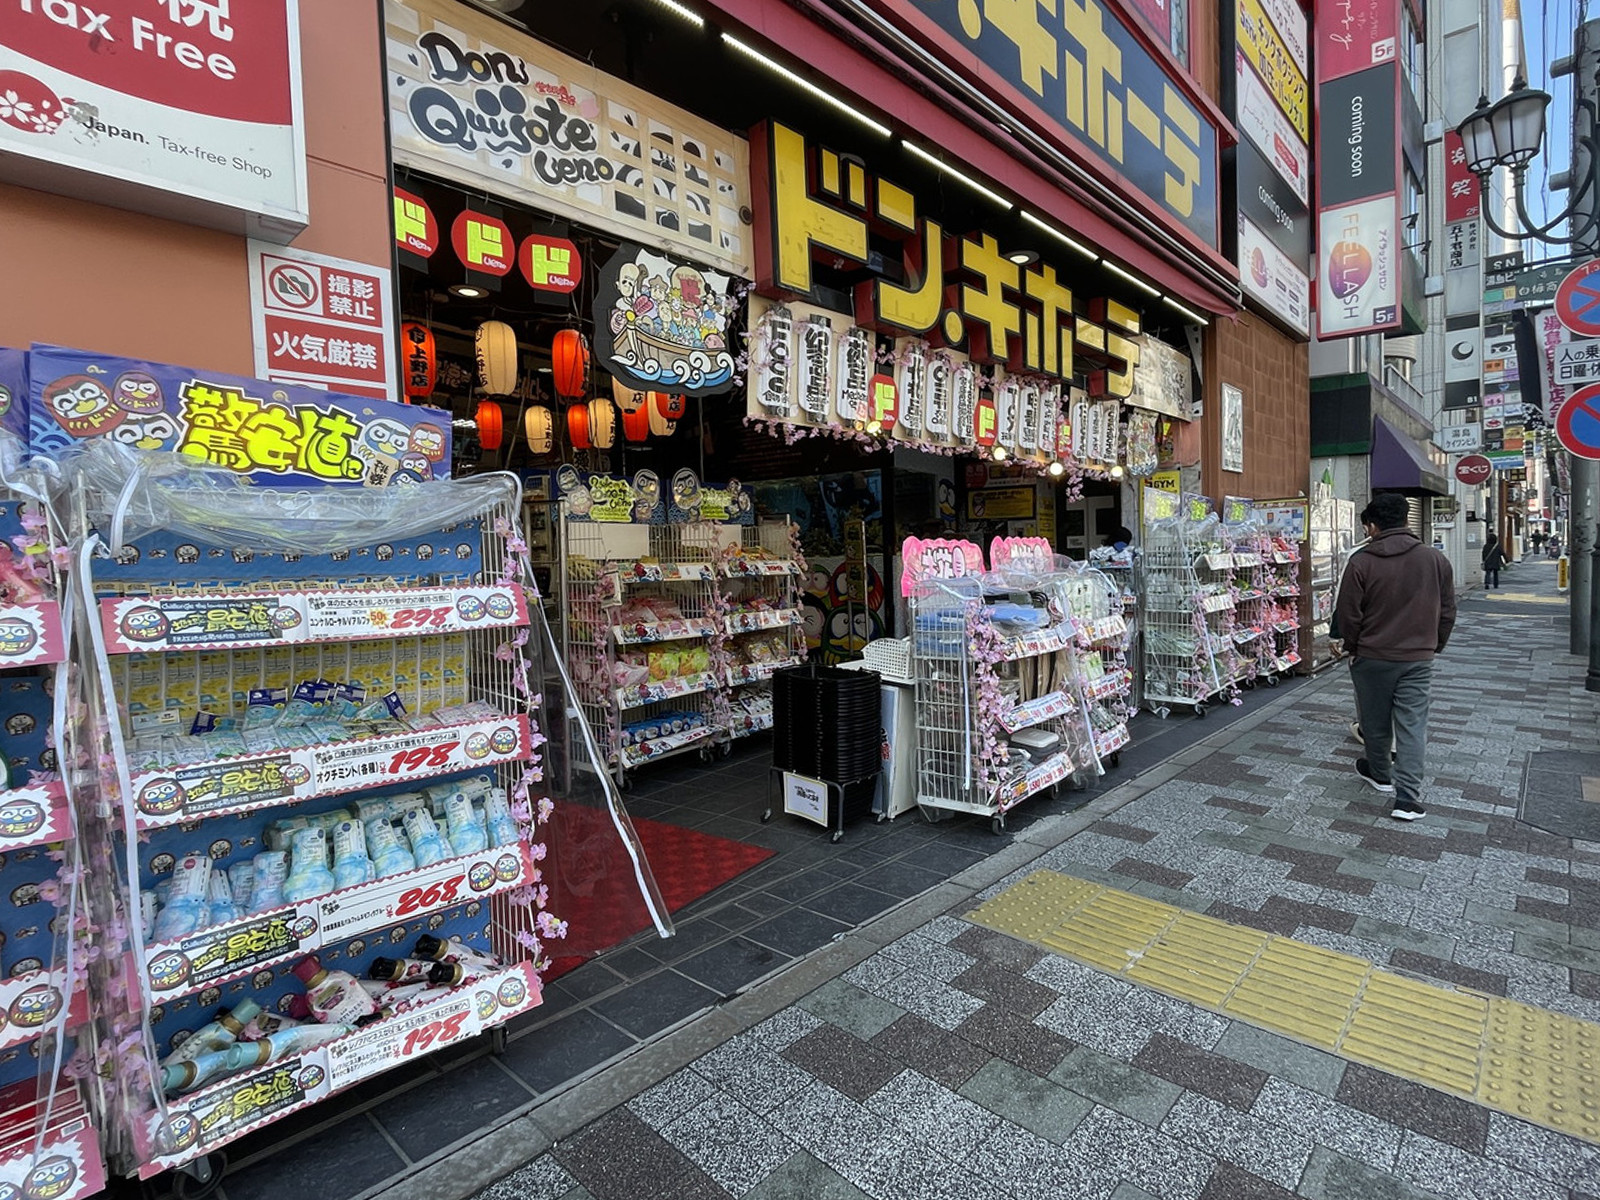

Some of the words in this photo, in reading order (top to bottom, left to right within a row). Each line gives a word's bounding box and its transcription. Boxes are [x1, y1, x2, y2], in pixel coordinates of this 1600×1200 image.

[131, 16, 237, 81] Free
[417, 32, 529, 86] Don
[1375, 44, 1394, 58] 5F
[1351, 96, 1362, 144] coming
[82, 114, 150, 146] Japan.
[157, 134, 228, 168] Tax-free
[231, 155, 273, 180] Shop
[1351, 148, 1362, 178] soon
[533, 149, 615, 186] Ueno
[1258, 185, 1281, 223] coming
[1280, 208, 1294, 234] soon
[1343, 213, 1359, 320] FEELLASH
[328, 274, 374, 299] 撮影
[329, 295, 376, 320] 禁止
[1375, 310, 1395, 324] 5F
[272, 330, 378, 370] 火気厳禁
[1154, 480, 1175, 488] GYM
[1458, 465, 1488, 475] 宝くじ
[390, 606, 454, 629] 298
